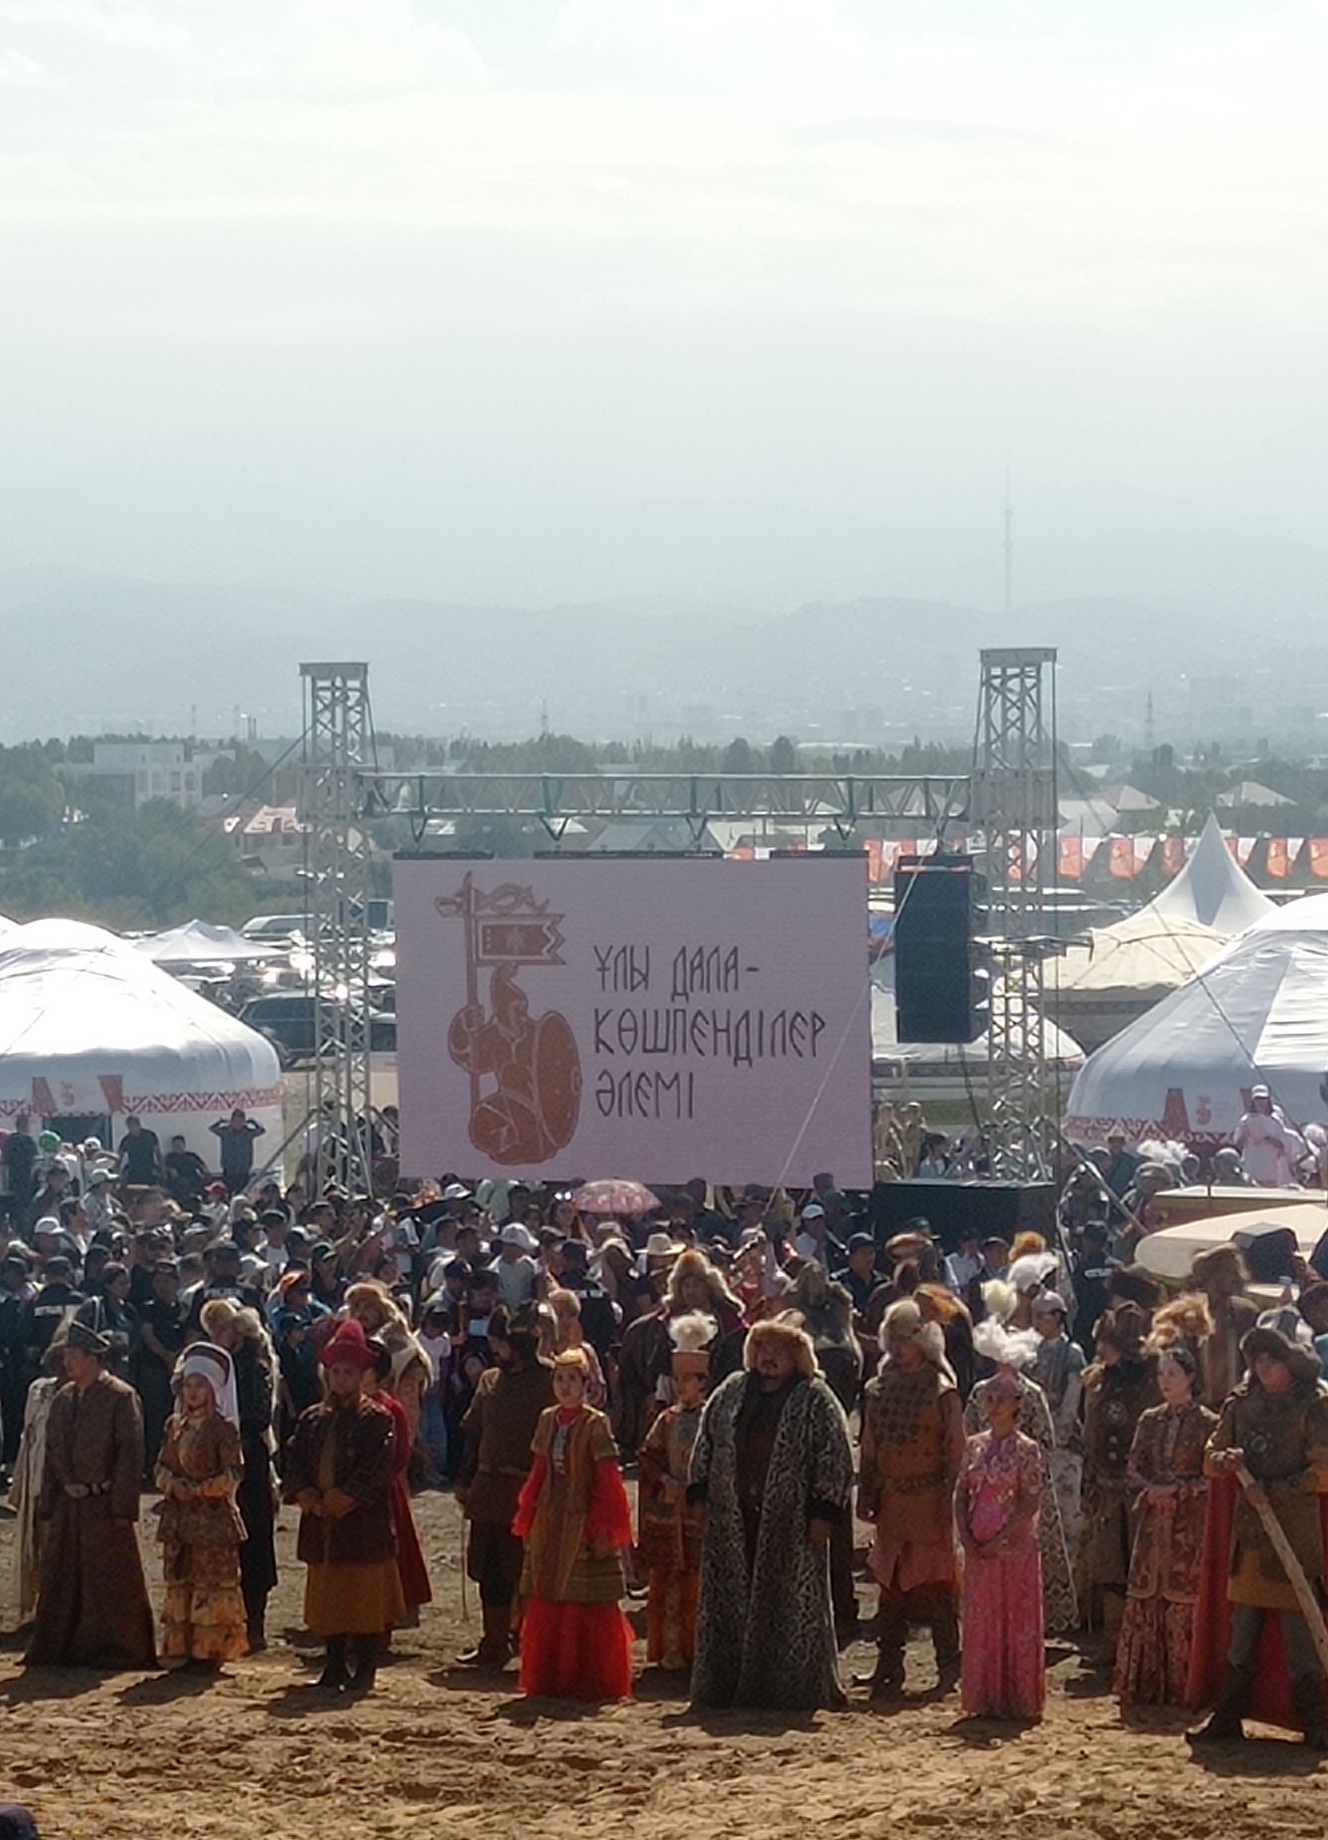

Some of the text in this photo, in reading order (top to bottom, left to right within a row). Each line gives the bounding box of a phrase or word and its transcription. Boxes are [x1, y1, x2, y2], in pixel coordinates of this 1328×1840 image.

[593, 945, 650, 992] ҰЛЫ
[595, 1008, 826, 1067] КӨШПЕНДІЛЕР
[597, 1071, 694, 1118] ӘЛЕМІ
